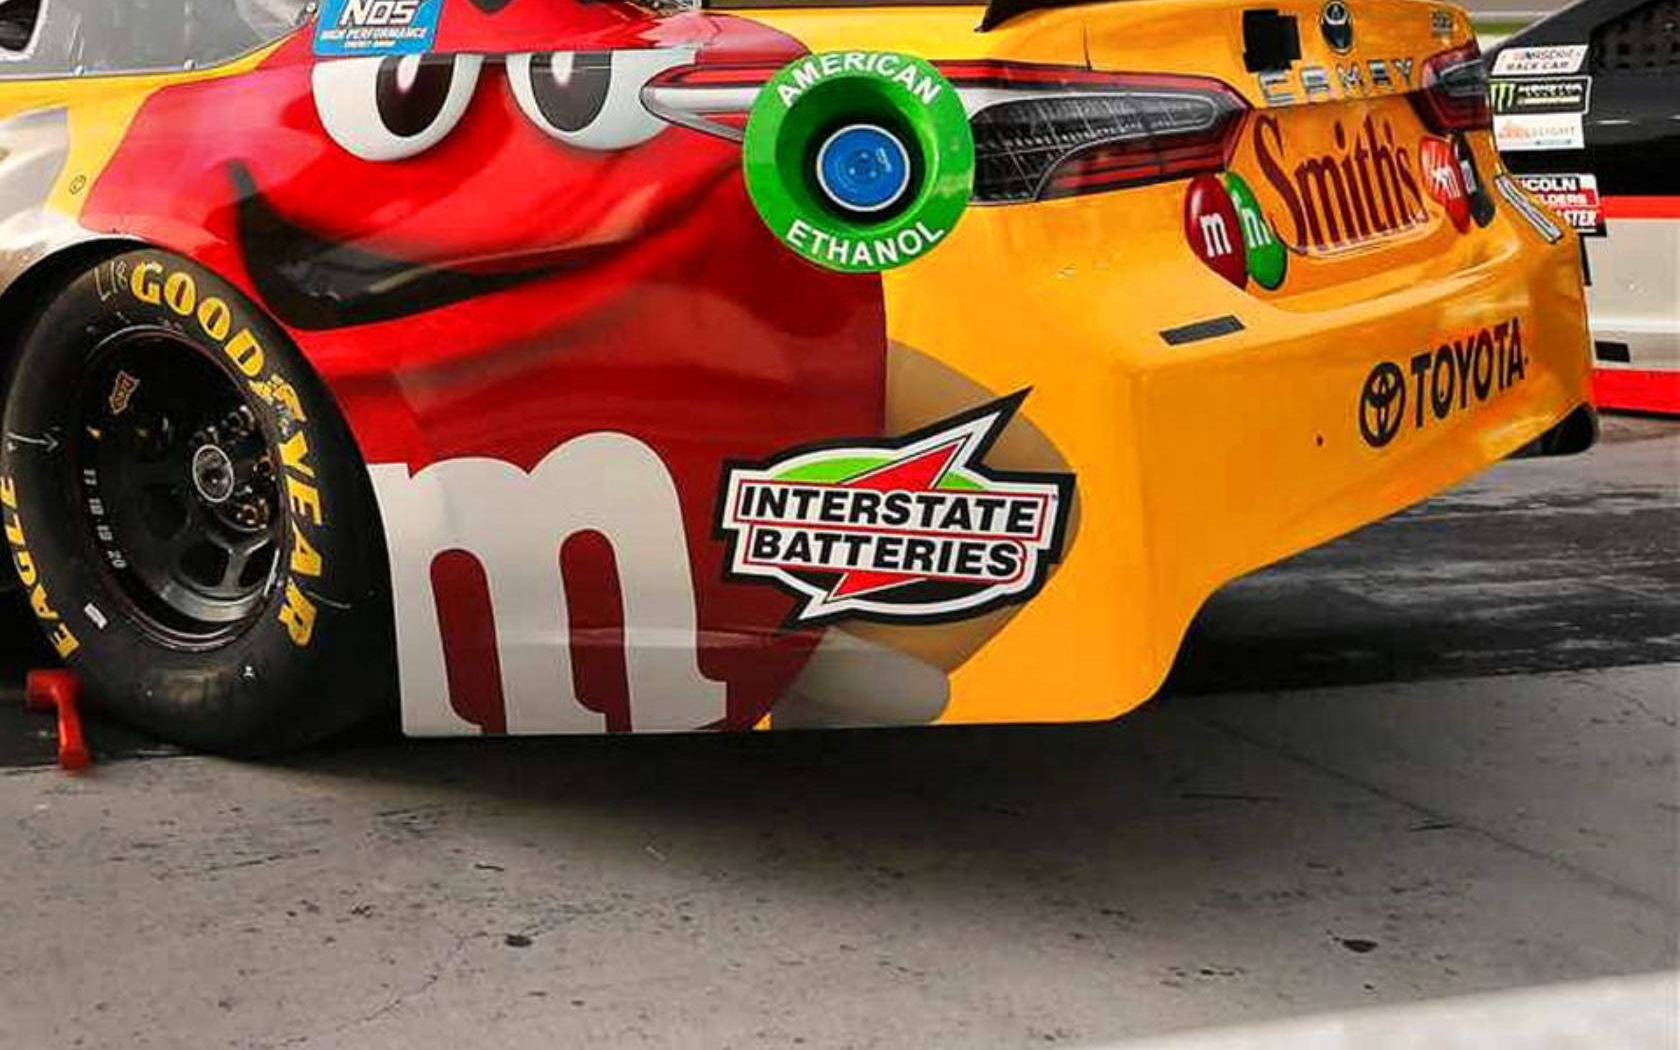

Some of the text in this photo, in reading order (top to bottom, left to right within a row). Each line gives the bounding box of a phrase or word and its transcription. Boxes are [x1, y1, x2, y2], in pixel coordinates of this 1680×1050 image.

[776, 51, 943, 108] AMERICAN
[1253, 111, 1430, 255] Smith's
[1523, 178, 1577, 192] COLN
[785, 219, 945, 267] ETHANOL
[1410, 316, 1526, 429] TOYOTA
[130, 261, 323, 648] GOODYEAR
[740, 485, 1039, 534] INTERSTATE
[0, 475, 80, 658] EAGLE
[751, 530, 1023, 578] BATTERIES
